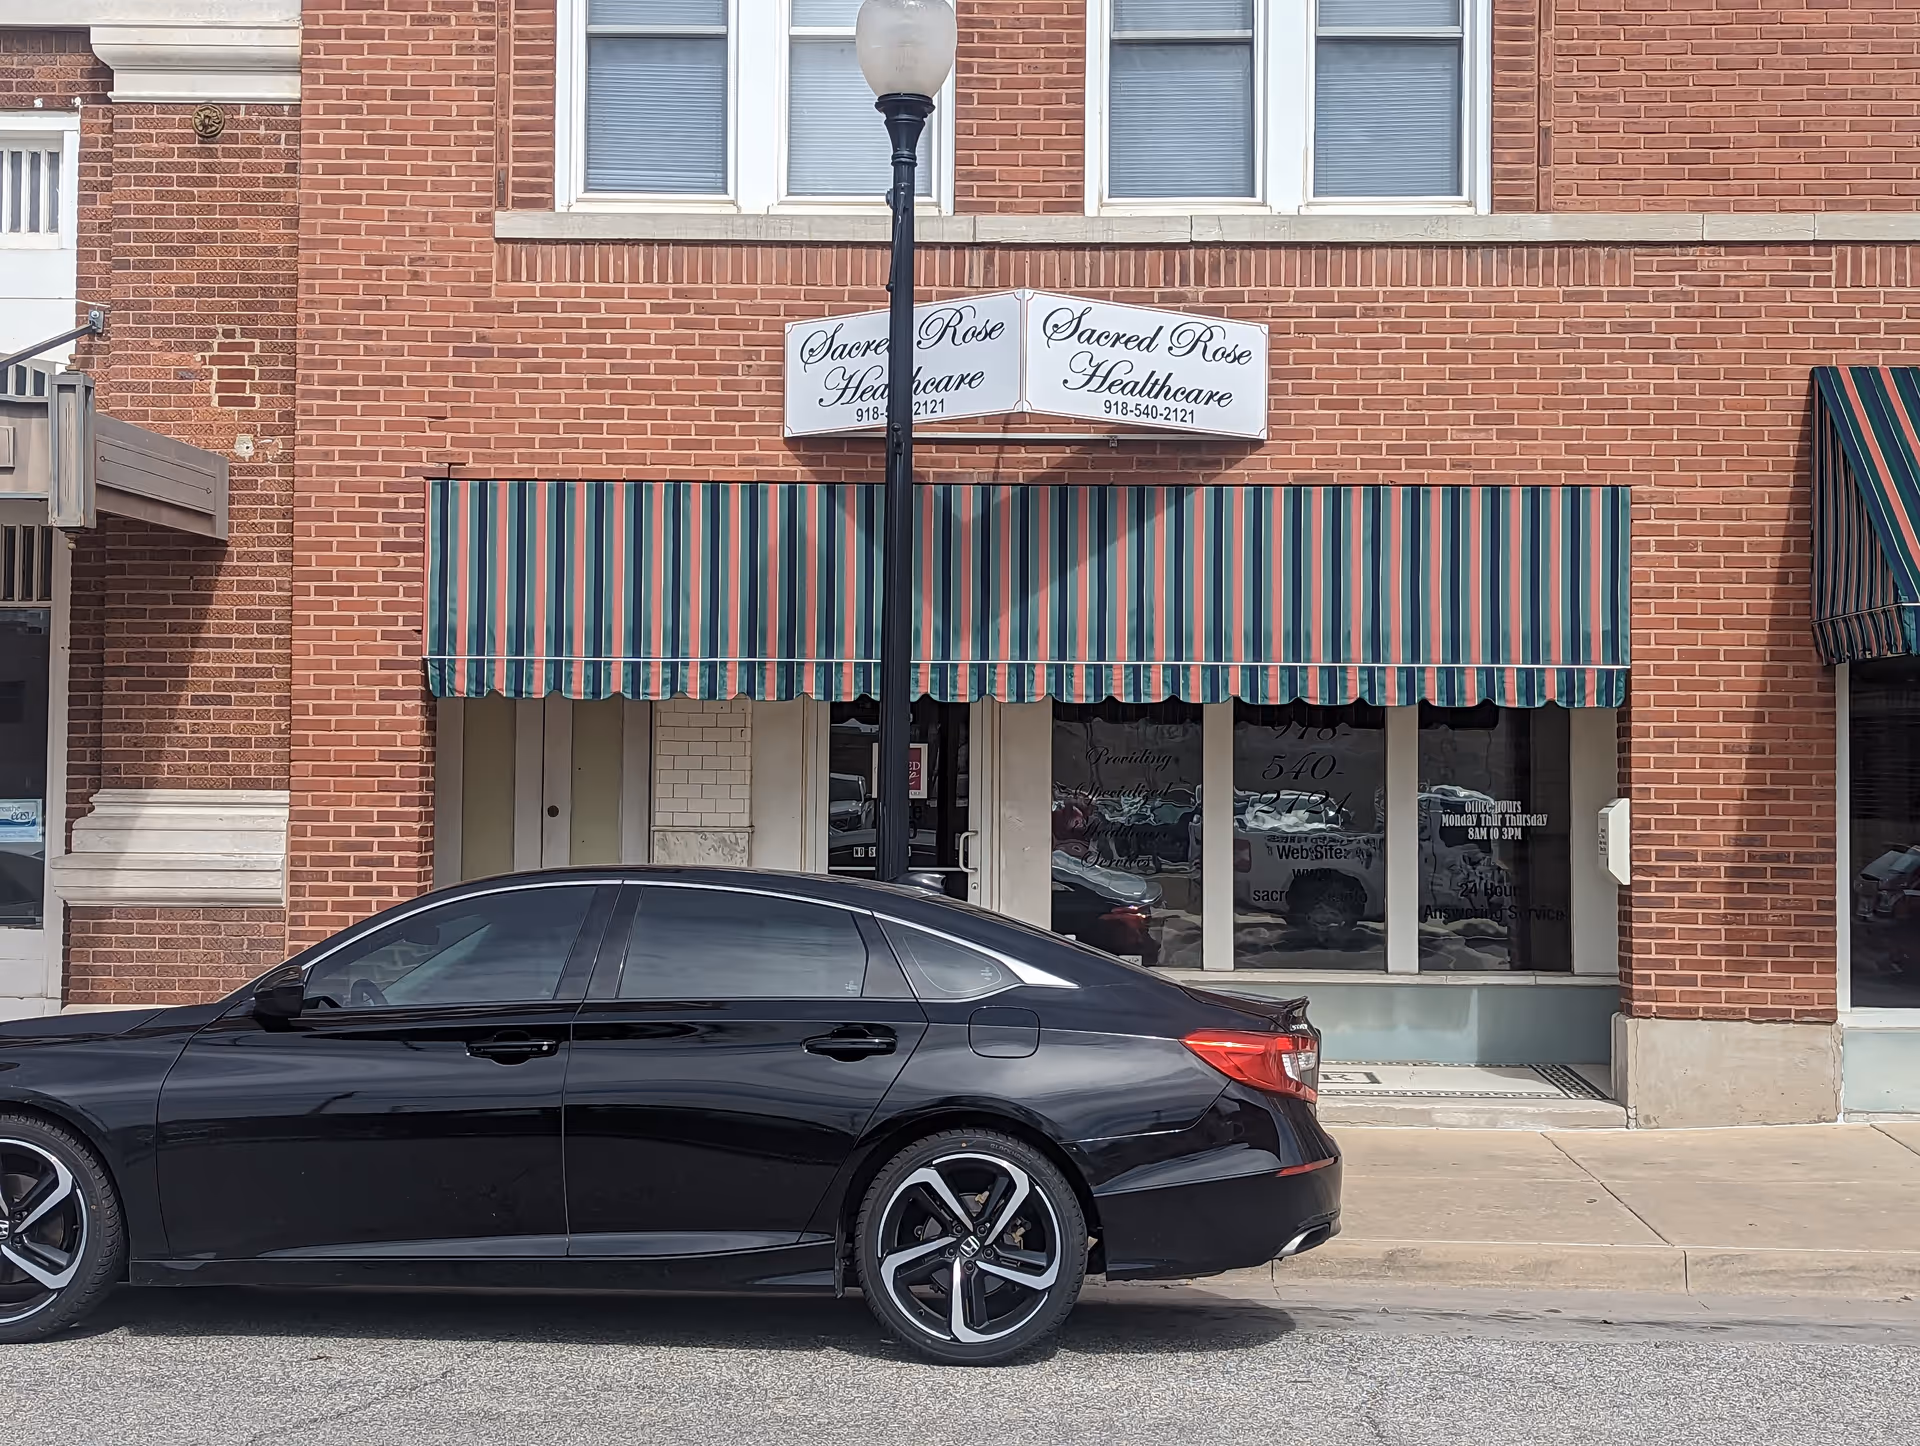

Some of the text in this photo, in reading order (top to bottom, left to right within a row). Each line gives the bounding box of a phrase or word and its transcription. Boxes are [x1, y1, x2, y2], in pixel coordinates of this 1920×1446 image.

[800, 305, 1005, 373] Sacre Rose
[1043, 306, 1253, 366] Sacred Rose
[818, 364, 985, 408] Heahcare
[1062, 350, 1234, 408] Healthcare
[855, 398, 946, 423] 918-2121
[1103, 399, 1195, 425] 918-540-2121
[1086, 746, 1173, 772] Providing
[1262, 752, 1345, 780] 540-
[1255, 789, 1353, 815] 2121
[1442, 813, 1549, 828] Monday Thur Thursday
[1468, 827, 1488, 840] 8AM
[1501, 827, 1522, 840] 3PM
[1276, 845, 1309, 860] Web
[1460, 882, 1478, 898] 24
